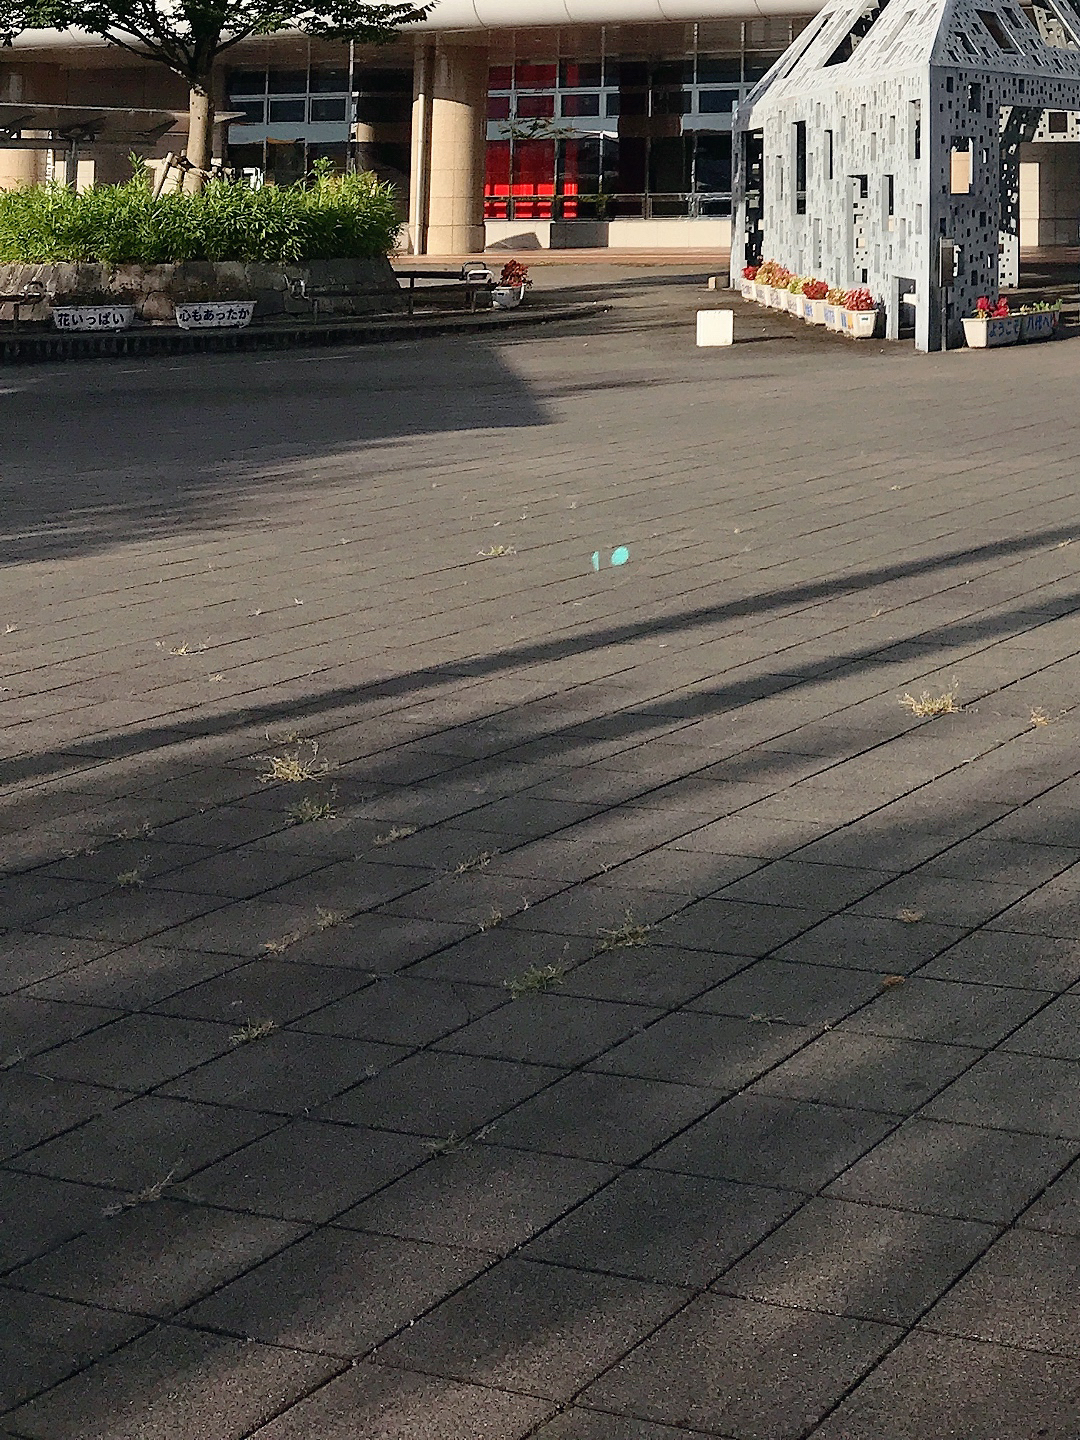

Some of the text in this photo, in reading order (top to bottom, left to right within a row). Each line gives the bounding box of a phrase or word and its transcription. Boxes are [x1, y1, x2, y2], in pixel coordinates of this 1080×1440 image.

[57, 311, 125, 327] 花いっぱい
[178, 307, 250, 322] 心もあったか
